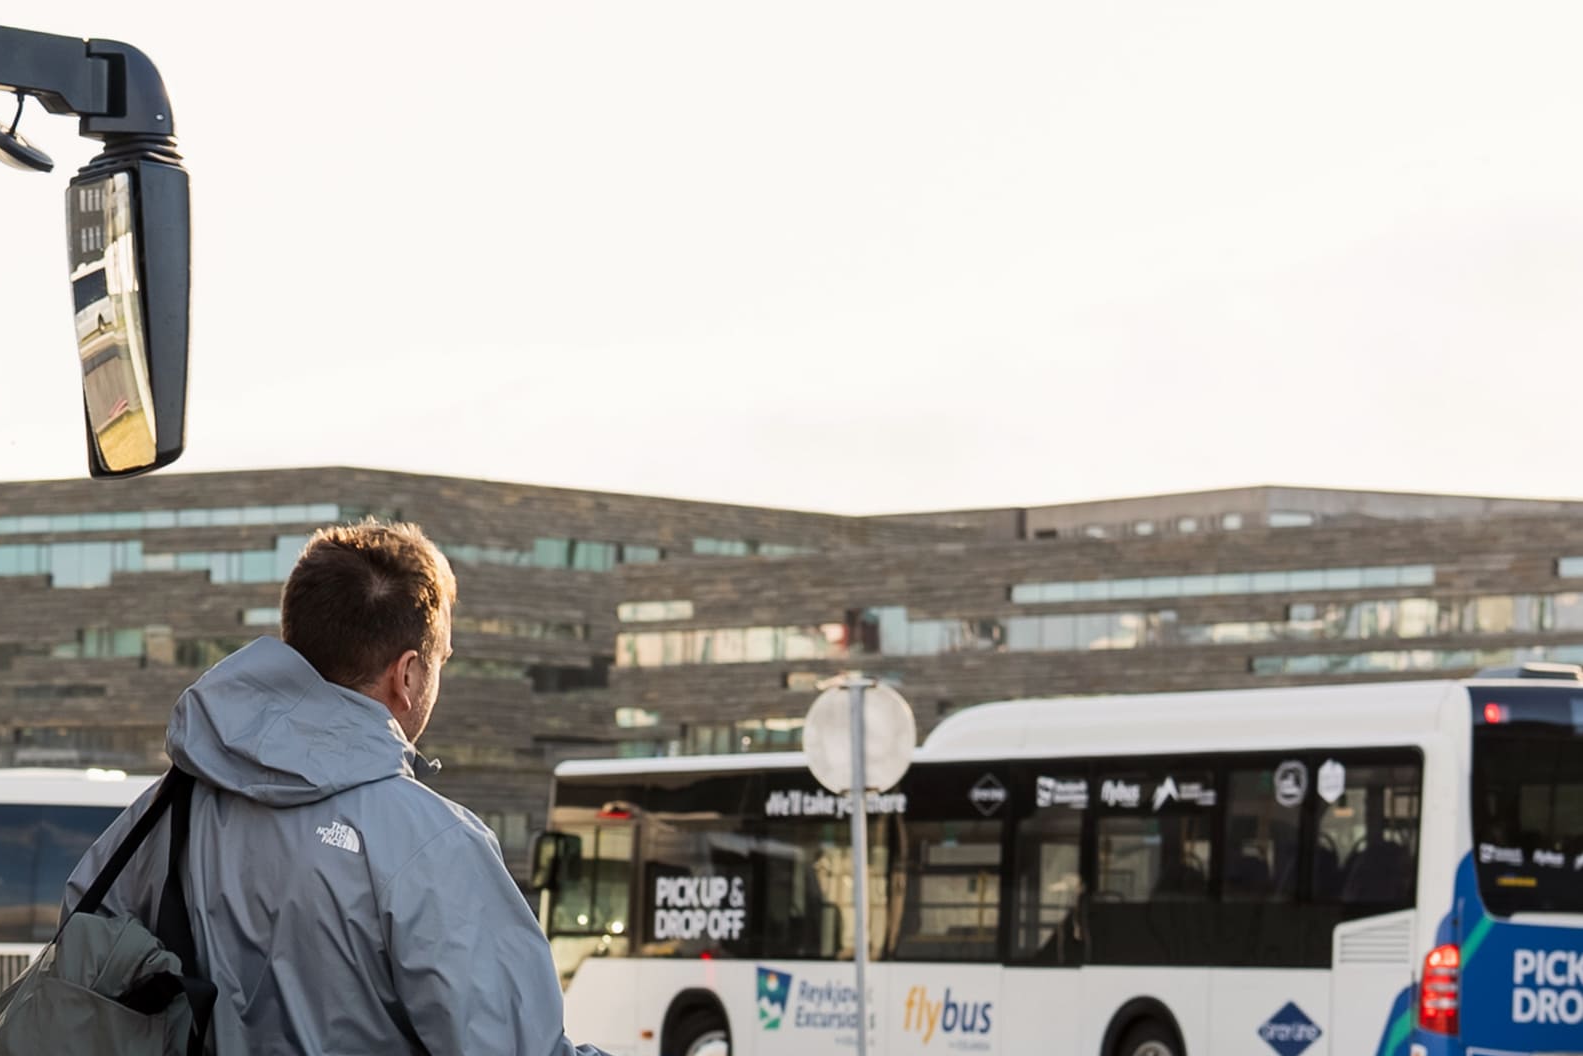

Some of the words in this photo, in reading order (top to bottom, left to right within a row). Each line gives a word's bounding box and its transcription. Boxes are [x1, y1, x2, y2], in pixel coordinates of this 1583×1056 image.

[316, 826, 347, 841] NORTH
[321, 834, 347, 849] FACE
[656, 876, 699, 908] PICK
[700, 876, 728, 908] UP
[654, 908, 706, 940] DROP
[707, 908, 746, 940] OFF
[904, 984, 993, 1046] flybus
